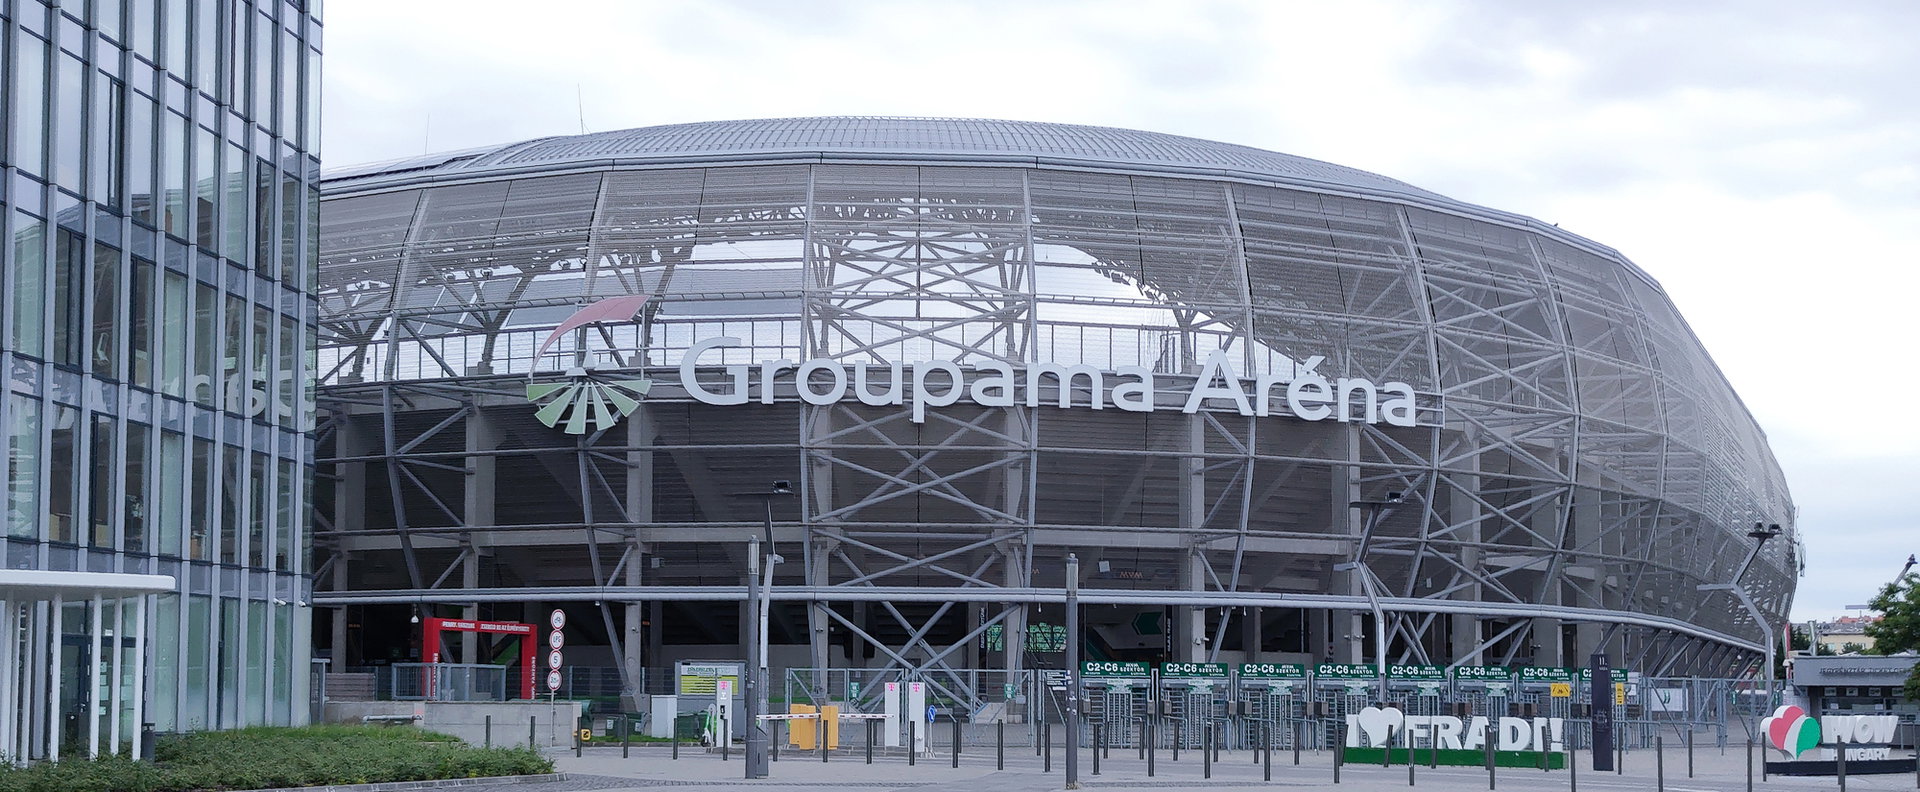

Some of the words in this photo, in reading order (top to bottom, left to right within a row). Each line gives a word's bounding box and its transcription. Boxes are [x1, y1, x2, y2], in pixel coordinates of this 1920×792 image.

[679, 336, 1154, 424] Groupama
[1182, 349, 1416, 427] Aréna
[553, 655, 558, 664] 5
[1086, 662, 1118, 672] C2-C6
[1166, 663, 1197, 673] C2-C6
[1244, 664, 1275, 673] C2-C6
[1319, 664, 1349, 674] C2-C6
[1391, 665, 1418, 675] C2-C6
[1459, 666, 1485, 676] C2-C6
[1523, 667, 1548, 677] C2-C6
[1404, 715, 1564, 752] FRADI!
[1821, 715, 1899, 744] WOW
